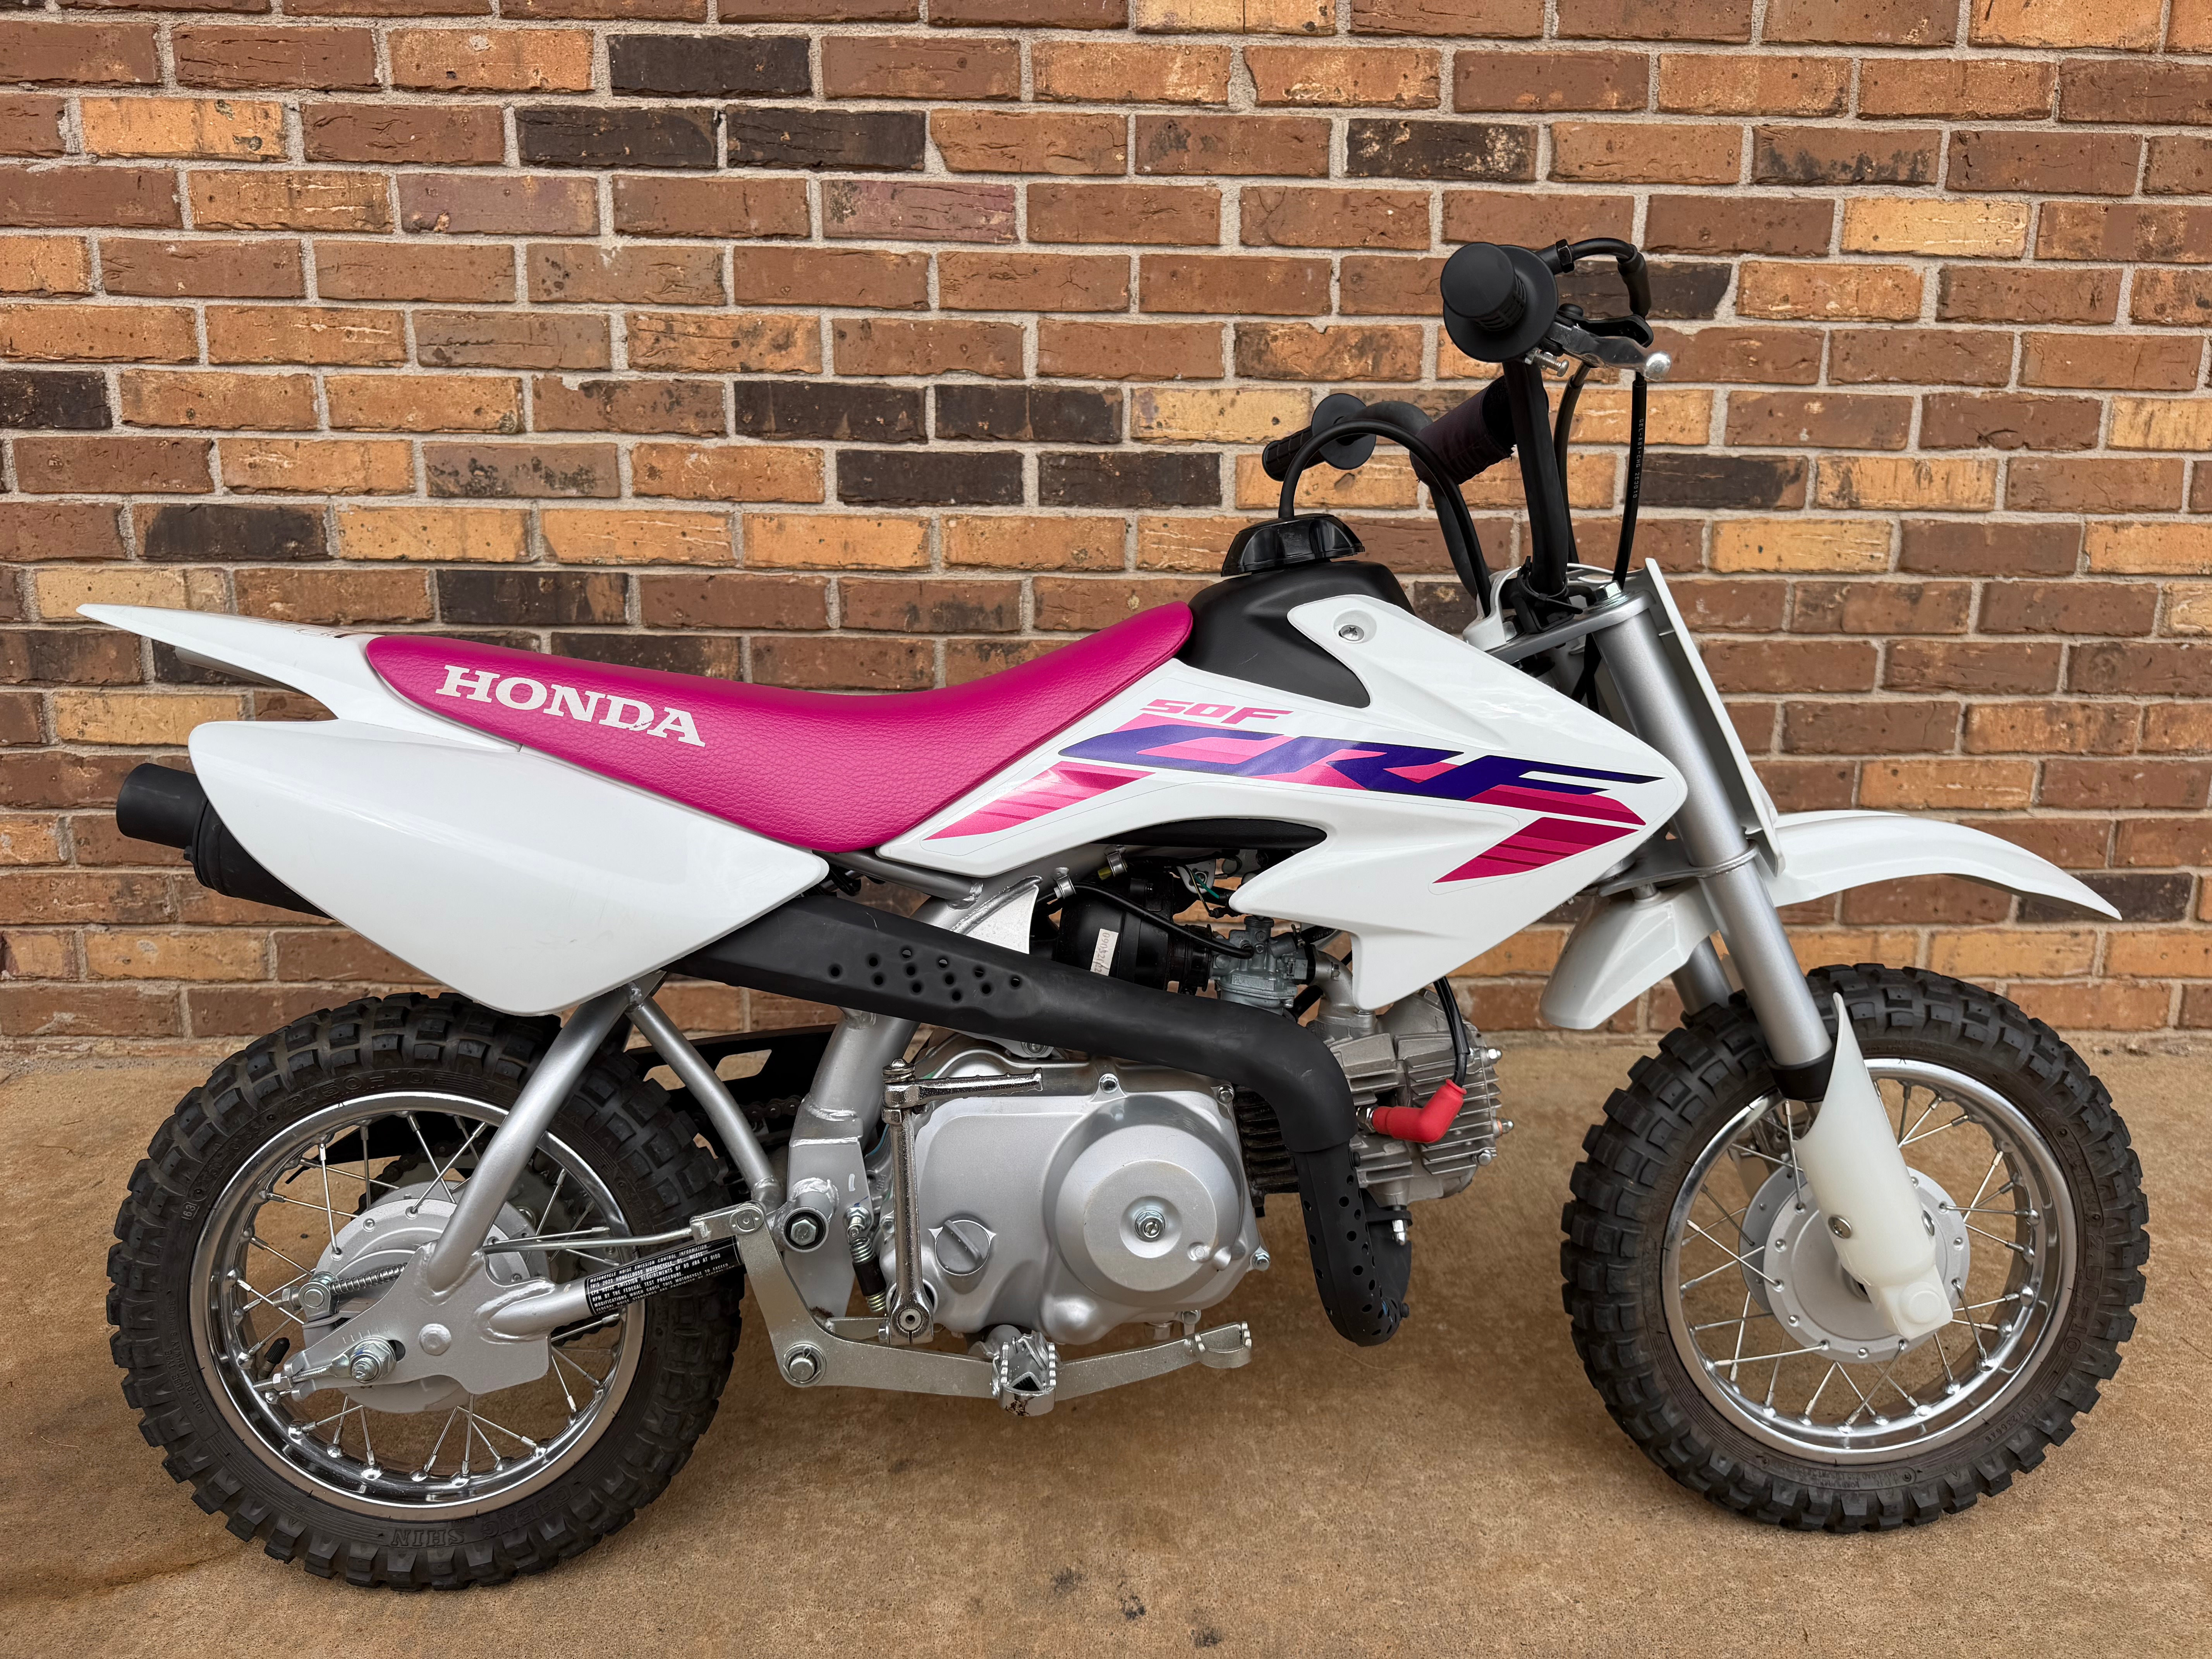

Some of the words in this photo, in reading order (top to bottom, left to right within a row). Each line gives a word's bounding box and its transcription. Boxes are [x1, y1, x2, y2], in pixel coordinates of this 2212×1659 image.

[436, 665, 706, 747] HONDA
[1139, 698, 1293, 725] 50F
[1058, 725, 1664, 801] CRF
[634, 1260, 655, 1270] EMISSION
[657, 1253, 676, 1263] CONTROL
[594, 1294, 627, 1308] MODIFICATIONS
[646, 1284, 660, 1292] CAUSE
[675, 1271, 702, 1283] MOTORCYCLE
[623, 1283, 642, 1293] FEDERAL
[2063, 1234, 2105, 1355] 2.50-10
[168, 1299, 178, 1336] SERVICE
[171, 1340, 189, 1377] HIGHWAY
[172, 1373, 185, 1393] TUBE
[184, 1380, 196, 1396] FOR
[192, 1398, 206, 1414] NOT
[478, 1482, 576, 1540] CHENG
[390, 1526, 465, 1547] SHIN
